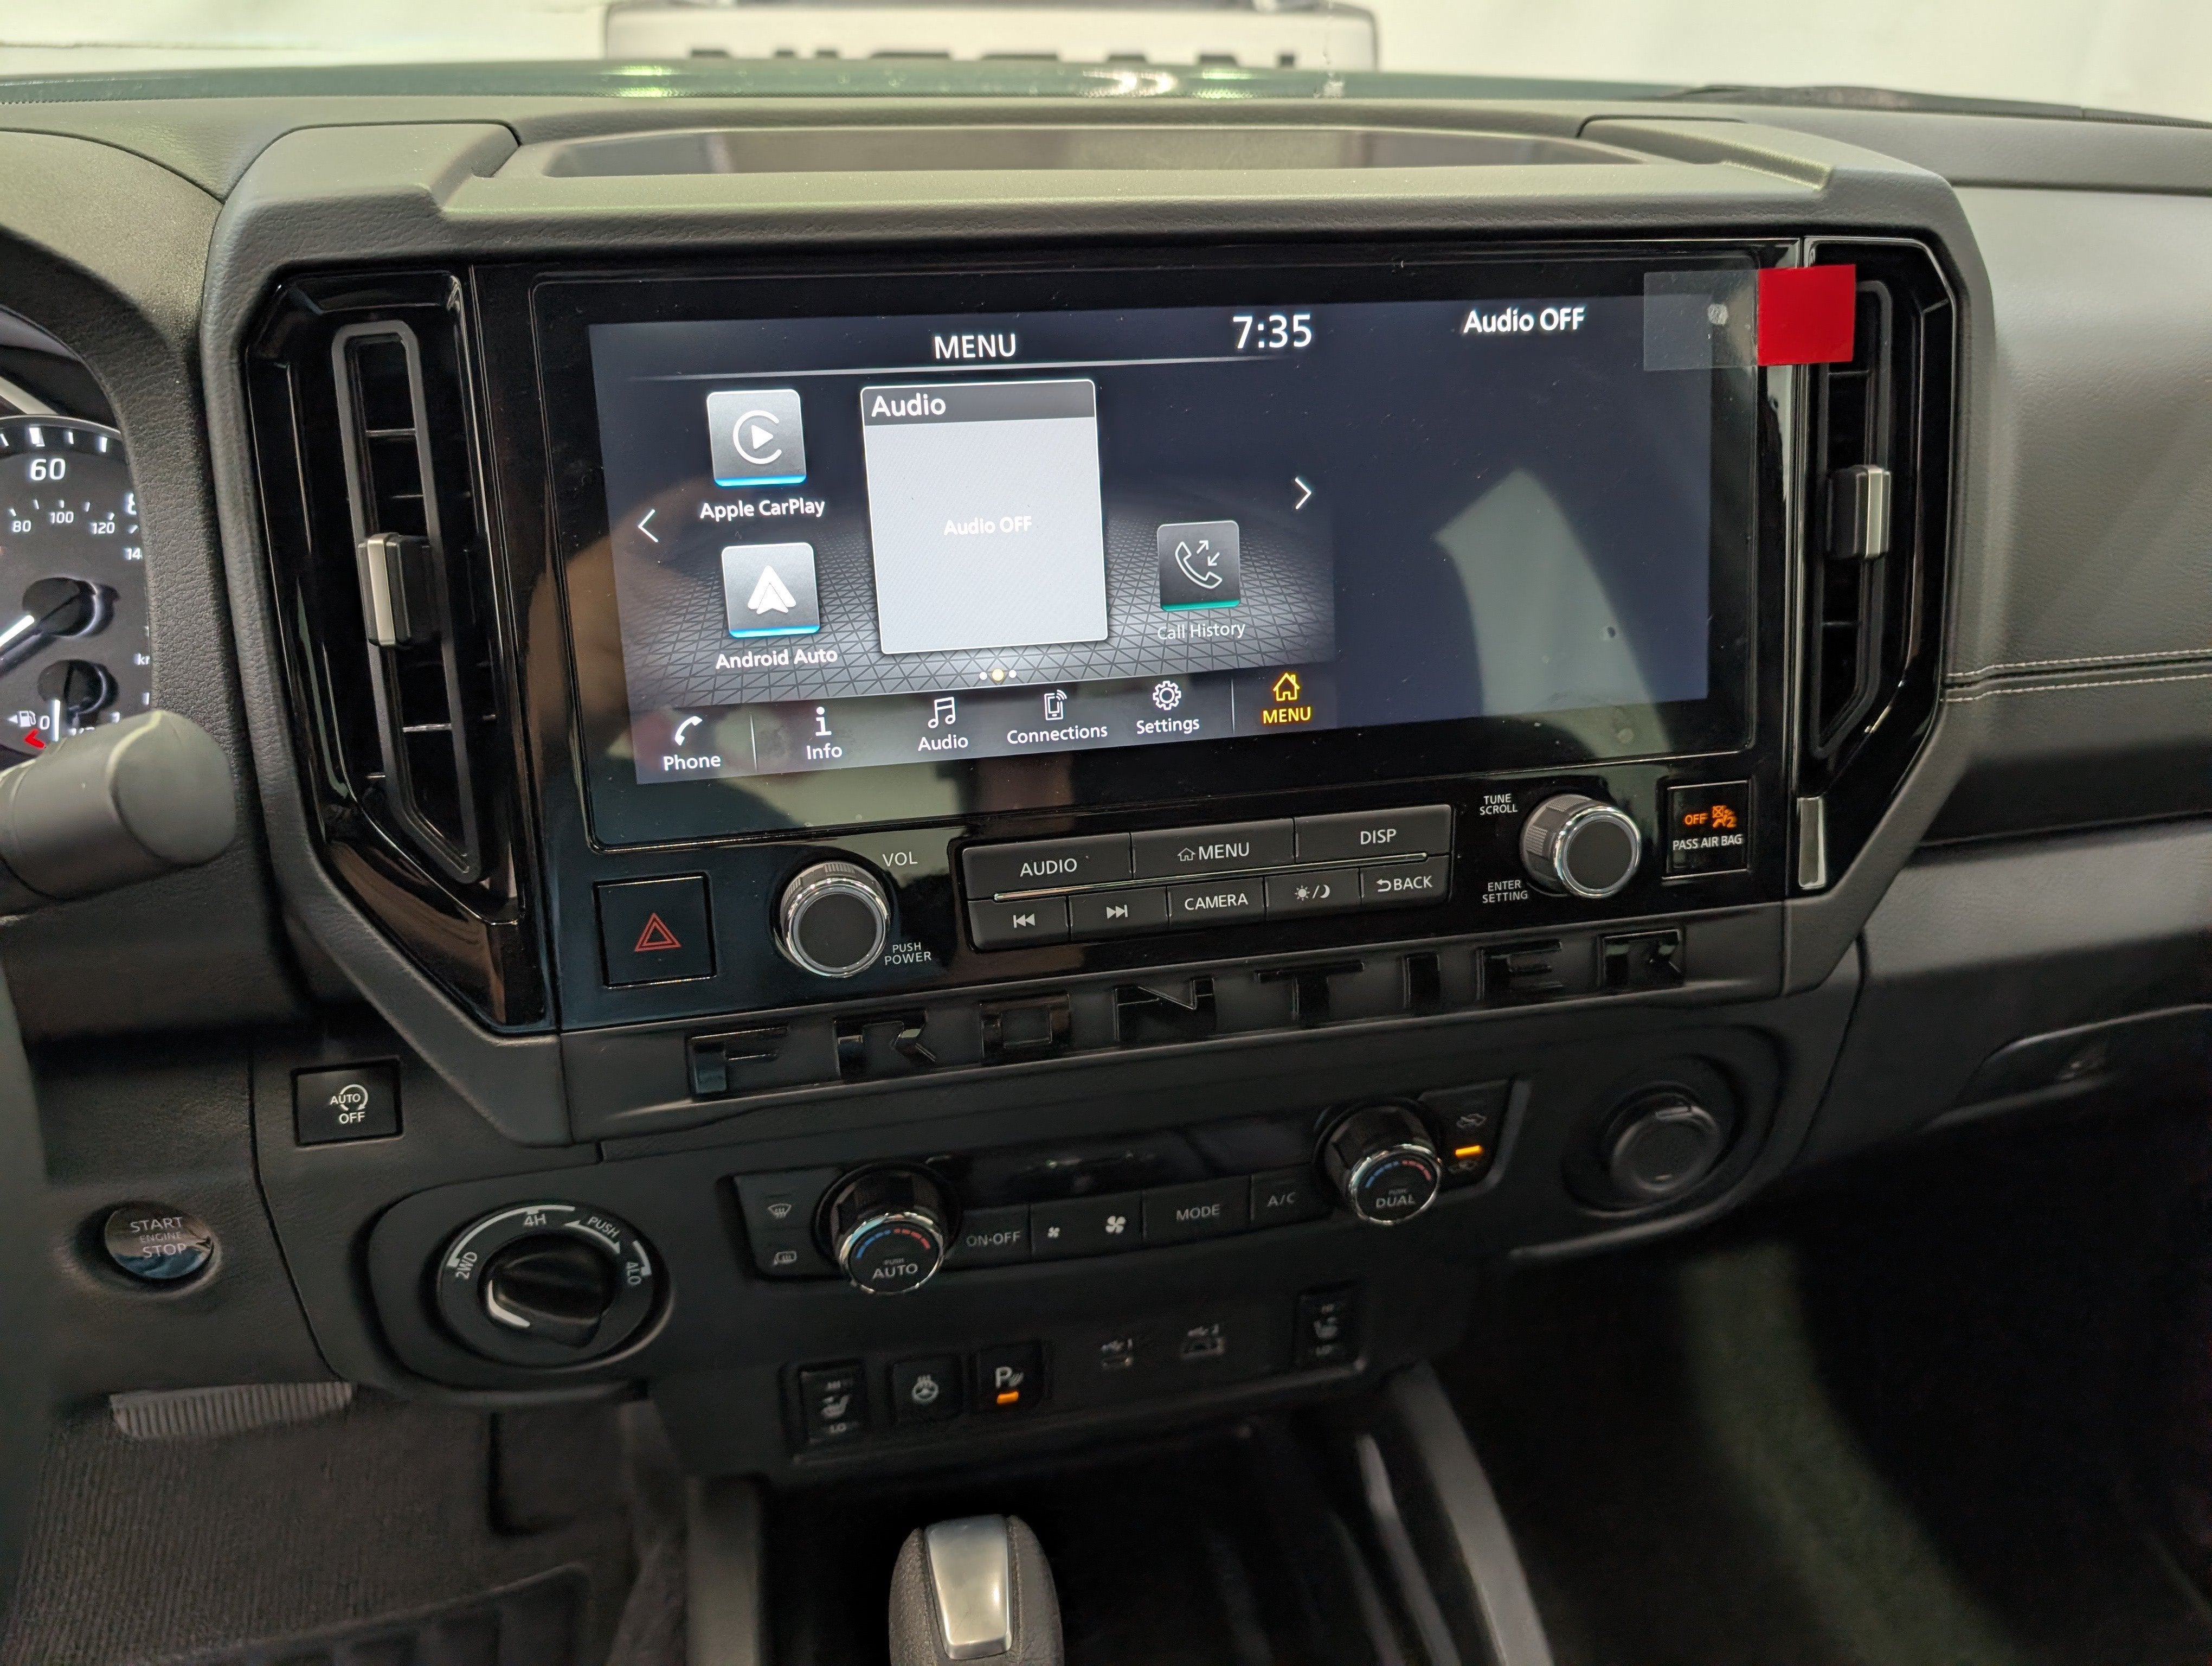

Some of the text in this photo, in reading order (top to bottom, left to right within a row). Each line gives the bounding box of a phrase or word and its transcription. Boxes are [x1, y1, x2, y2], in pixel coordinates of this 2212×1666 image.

[1463, 307, 1585, 334] Audio OFF
[1233, 313, 1313, 349] 7:35
[935, 334, 1016, 358] MENU
[871, 393, 946, 417] Audio
[30, 458, 66, 481] 60
[50, 511, 74, 524] 100
[700, 498, 825, 522] Apple CarPlay
[12, 521, 31, 533] 80
[92, 522, 115, 534] 120
[944, 517, 1032, 536] Audio OFF
[1157, 622, 1246, 640] Call History
[715, 649, 838, 669] Android Auto
[40, 716, 50, 731] 0
[1263, 707, 1311, 724] MENU
[1136, 717, 1200, 735] Settings
[1007, 725, 1108, 745] Connections
[806, 743, 843, 760] Info
[918, 735, 968, 752] Audio
[664, 755, 721, 771] Phone
[1483, 793, 1512, 805] TUNE
[1480, 804, 1517, 816] SCROLL
[1684, 813, 1708, 825] OFF
[1360, 829, 1397, 845] DISP
[1672, 834, 1744, 851] PASS AIR BAG
[882, 851, 918, 867] VOL
[1198, 842, 1250, 860] MENU
[1020, 858, 1078, 877] AUDIO
[1393, 876, 1432, 890] BACK
[1487, 879, 1521, 892] ENTER
[1184, 893, 1249, 911] CAMERA
[1482, 890, 1529, 904] SETTING
[892, 942, 922, 953] PUSH
[884, 951, 932, 965] POWER
[687, 930, 1684, 1094] FRONTIER
[329, 1093, 362, 1105] AUTO
[338, 1112, 365, 1124] OFF
[1268, 1192, 1296, 1207] A/C
[1375, 1195, 1414, 1209] DUAL
[524, 1214, 546, 1227] 4H
[1176, 1204, 1221, 1221] MODE
[130, 1217, 183, 1234] START
[587, 1215, 621, 1239] PUSH
[139, 1232, 182, 1244] ENGINE
[142, 1244, 187, 1259] STOP
[456, 1251, 478, 1280] 2WD
[872, 1264, 918, 1280] AUTO
